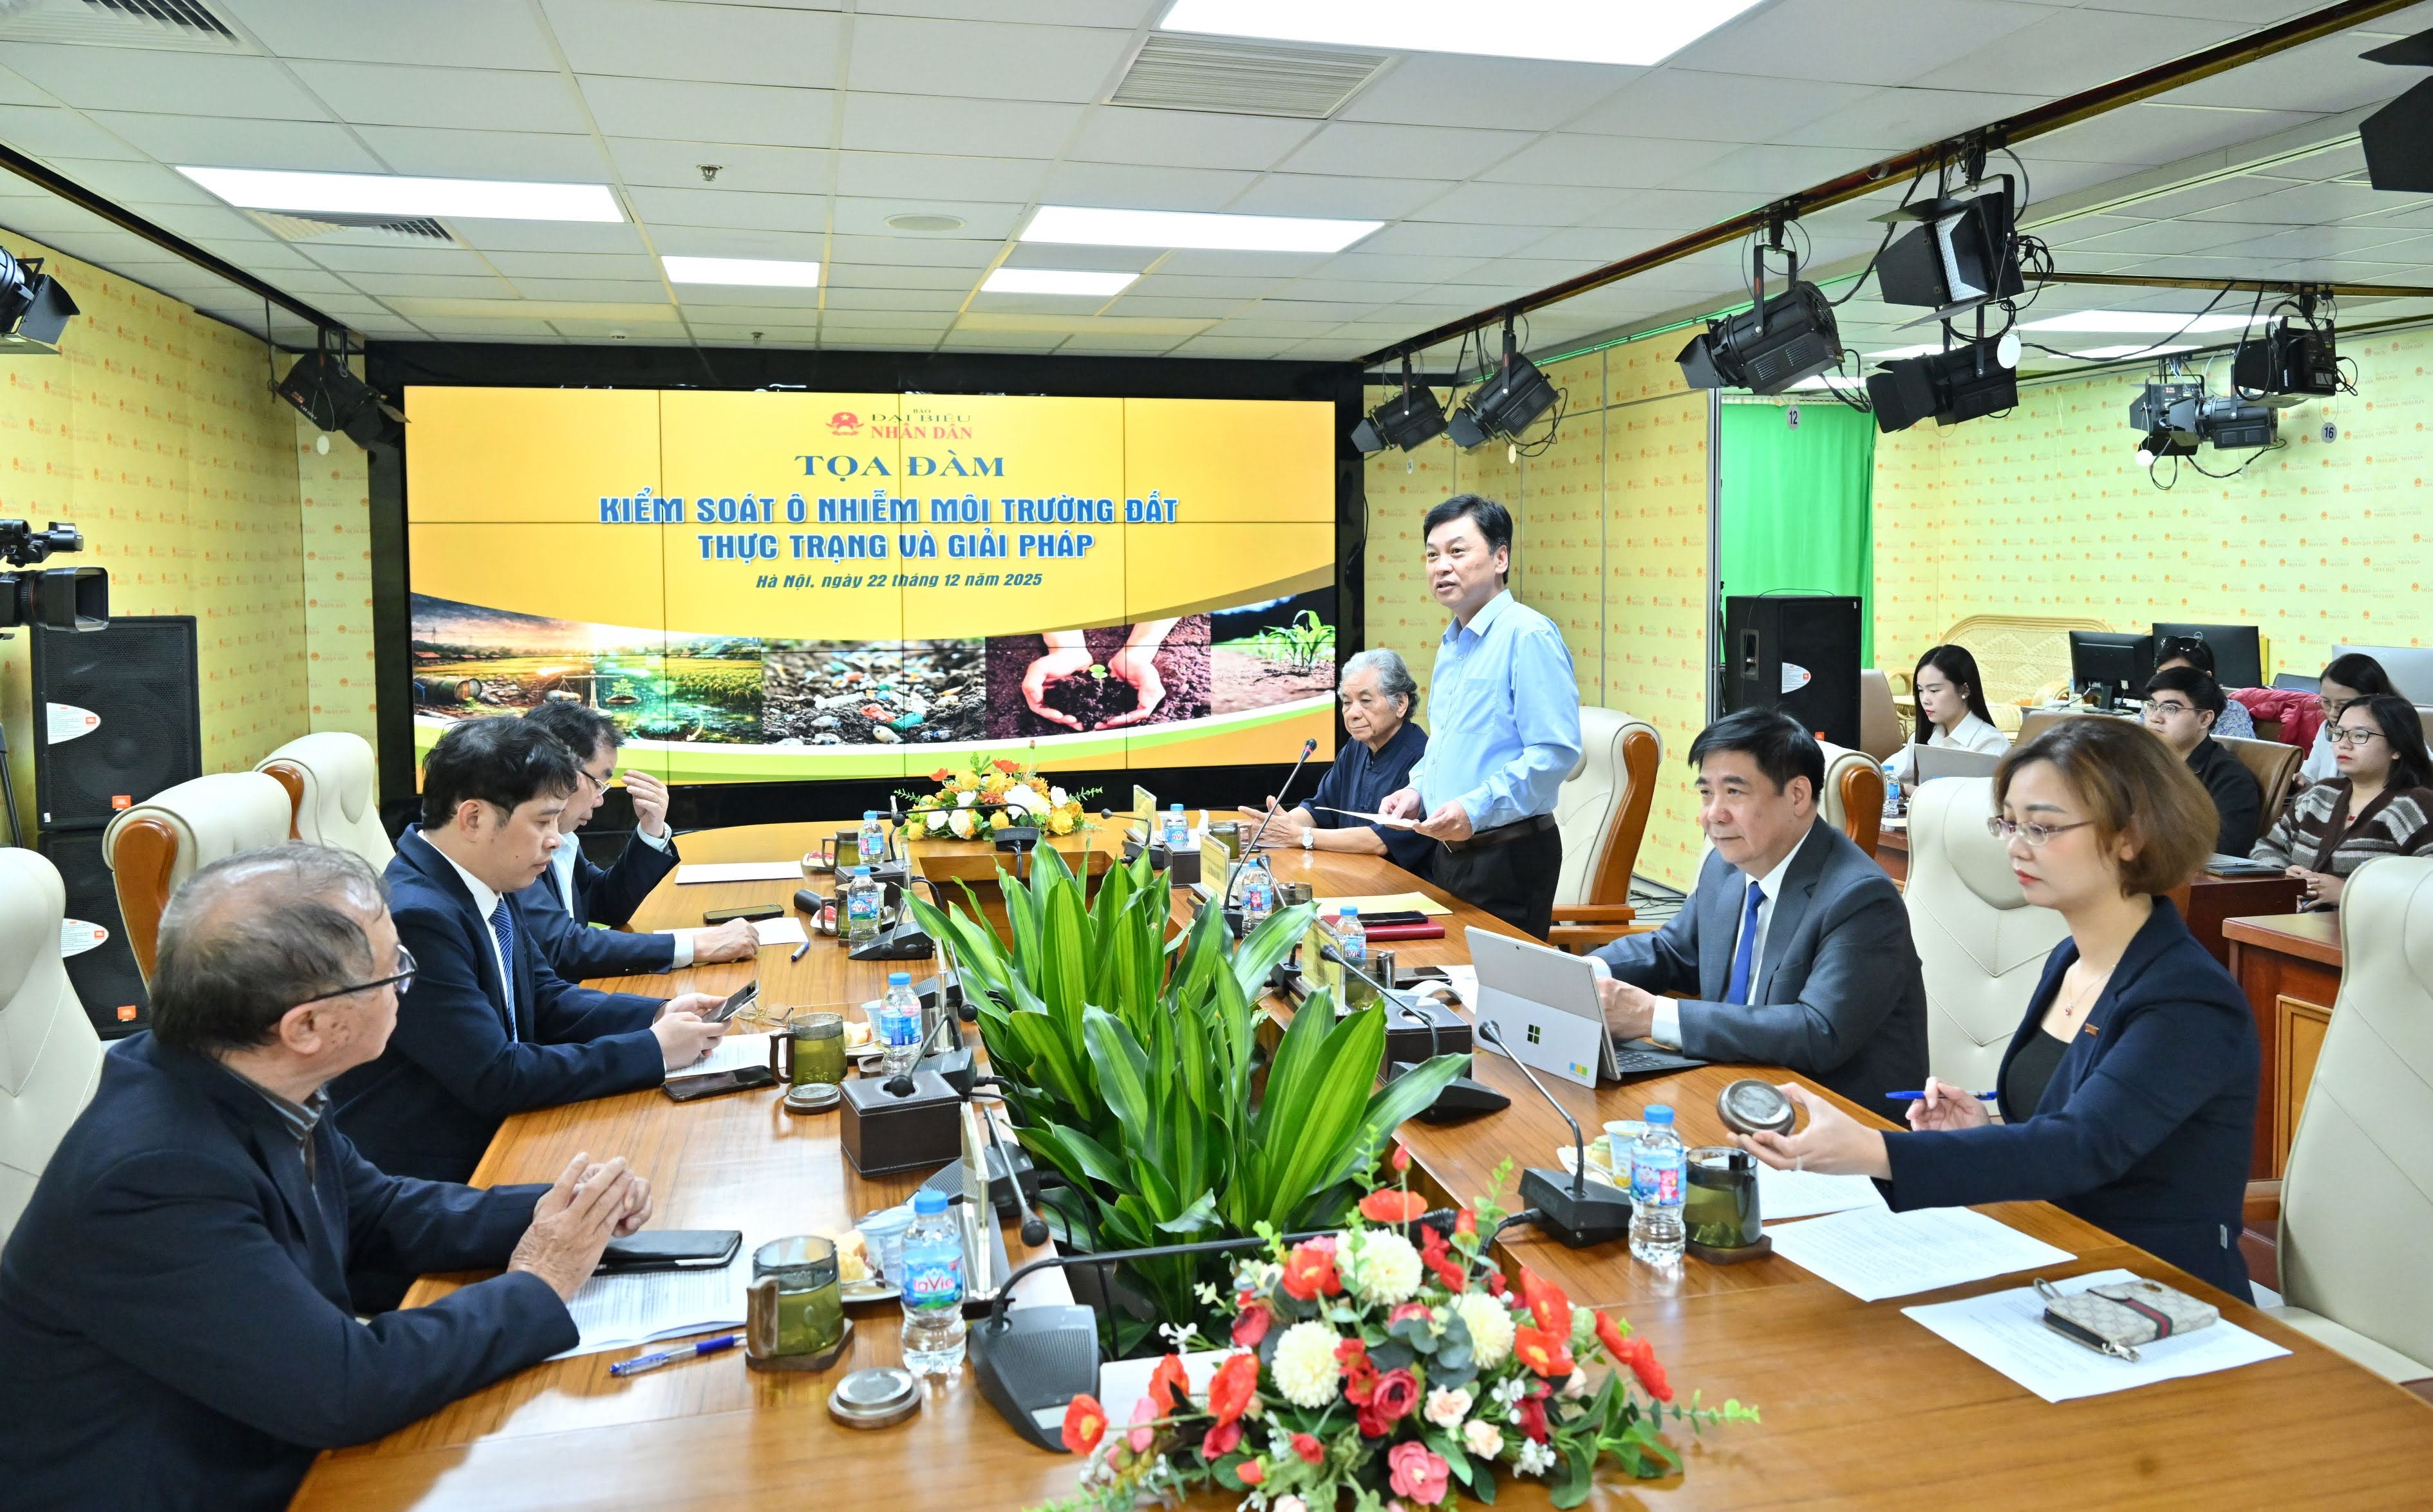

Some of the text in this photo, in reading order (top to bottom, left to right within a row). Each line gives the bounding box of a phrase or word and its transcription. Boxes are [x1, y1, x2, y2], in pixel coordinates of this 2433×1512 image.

[1789, 411, 1798, 424] 12
[871, 422, 973, 439] NHÂN DÂN
[2324, 427, 2334, 439] 16
[794, 449, 1004, 482] TỌA ĐÀM
[599, 487, 1178, 523] KIỂM SOÁT Ô NHIỄM MÔI TRƯỜNG ĐẤT
[698, 527, 1094, 565] THỰC TRẠNG VÀ GIẢI PHÁP
[756, 574, 1042, 591] Hà Nội, ngày 22 tháng 12 năm 2025
[914, 1274, 954, 1292] laVie
